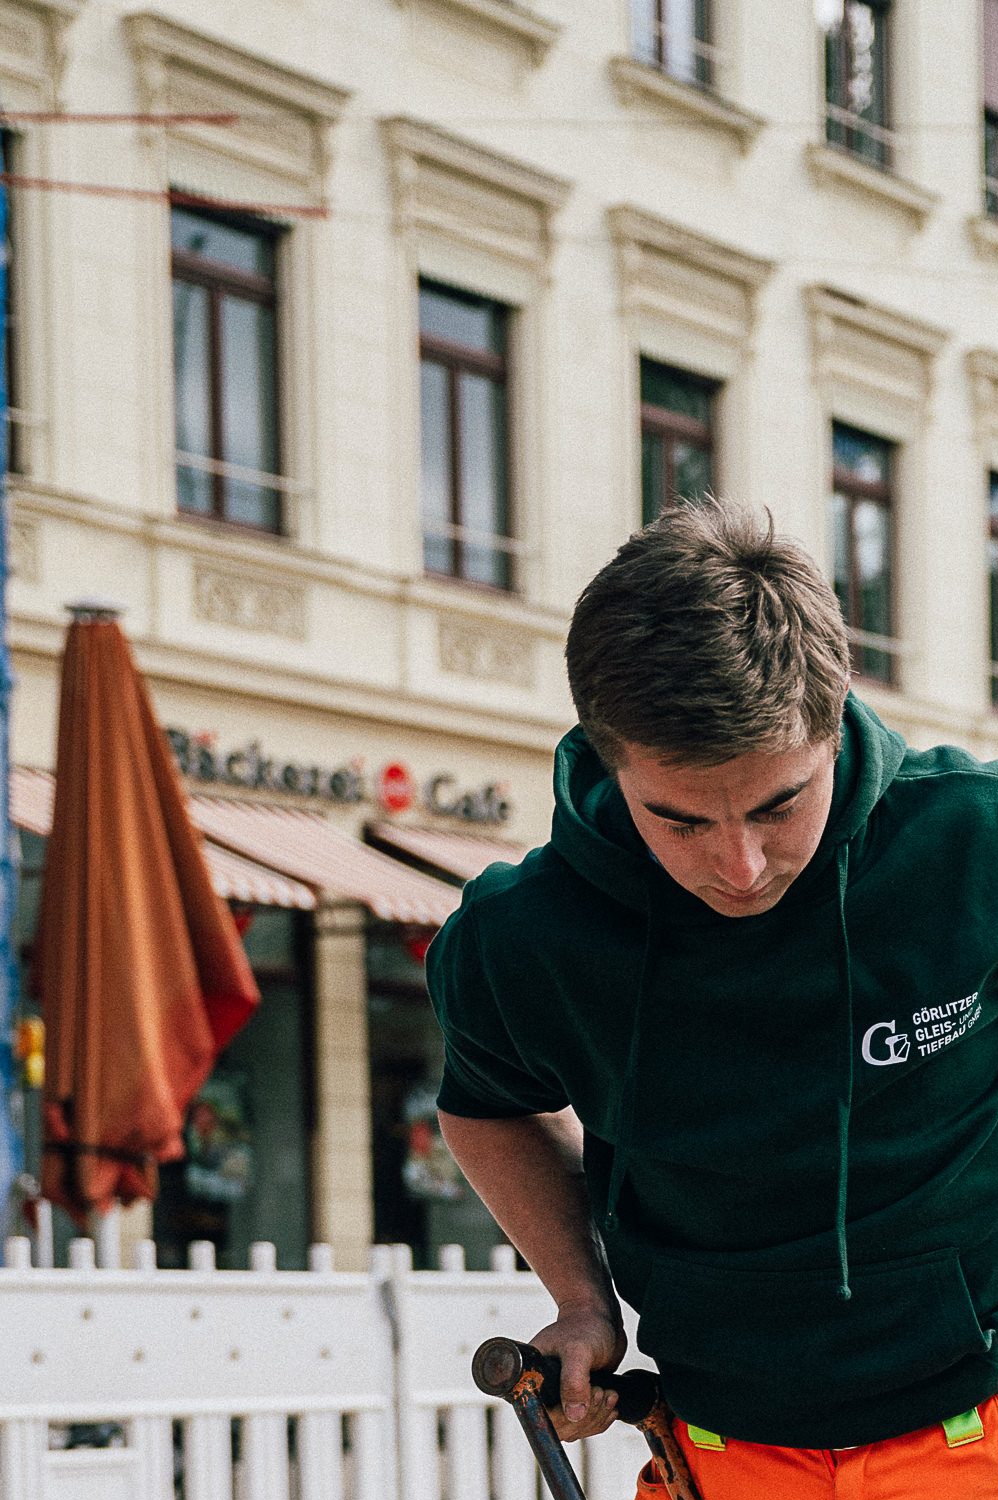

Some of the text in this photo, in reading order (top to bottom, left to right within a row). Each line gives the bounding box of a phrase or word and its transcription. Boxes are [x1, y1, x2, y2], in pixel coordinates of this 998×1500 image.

[912, 991, 979, 1026] GÖRLITZER
[915, 1020, 957, 1042] GLEIS-
[917, 1024, 967, 1057] TIEFBAU
